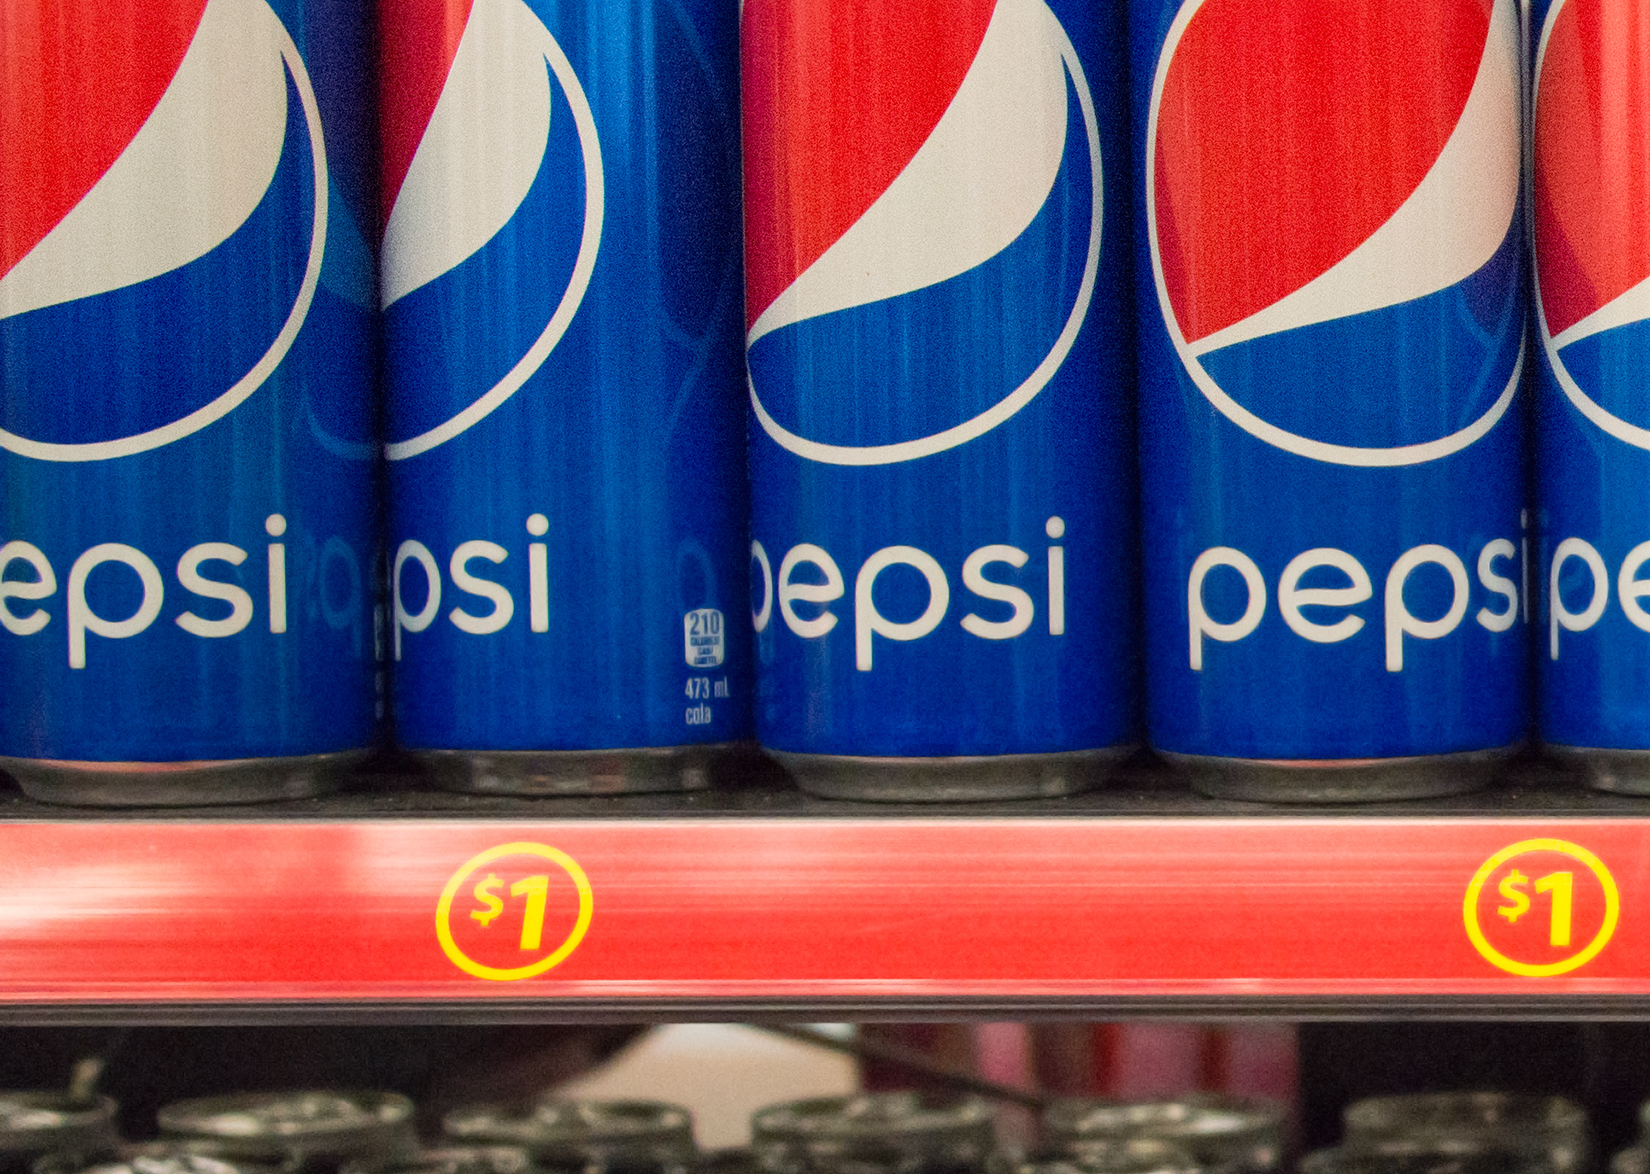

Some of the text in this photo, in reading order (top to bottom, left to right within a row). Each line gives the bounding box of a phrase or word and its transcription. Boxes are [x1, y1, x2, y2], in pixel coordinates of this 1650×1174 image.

[1187, 508, 1530, 672] pepsi
[689, 611, 720, 636] 210
[685, 677, 710, 699] 473
[685, 702, 712, 725] cola
[470, 872, 549, 950] $1
[1497, 868, 1573, 947] $1
